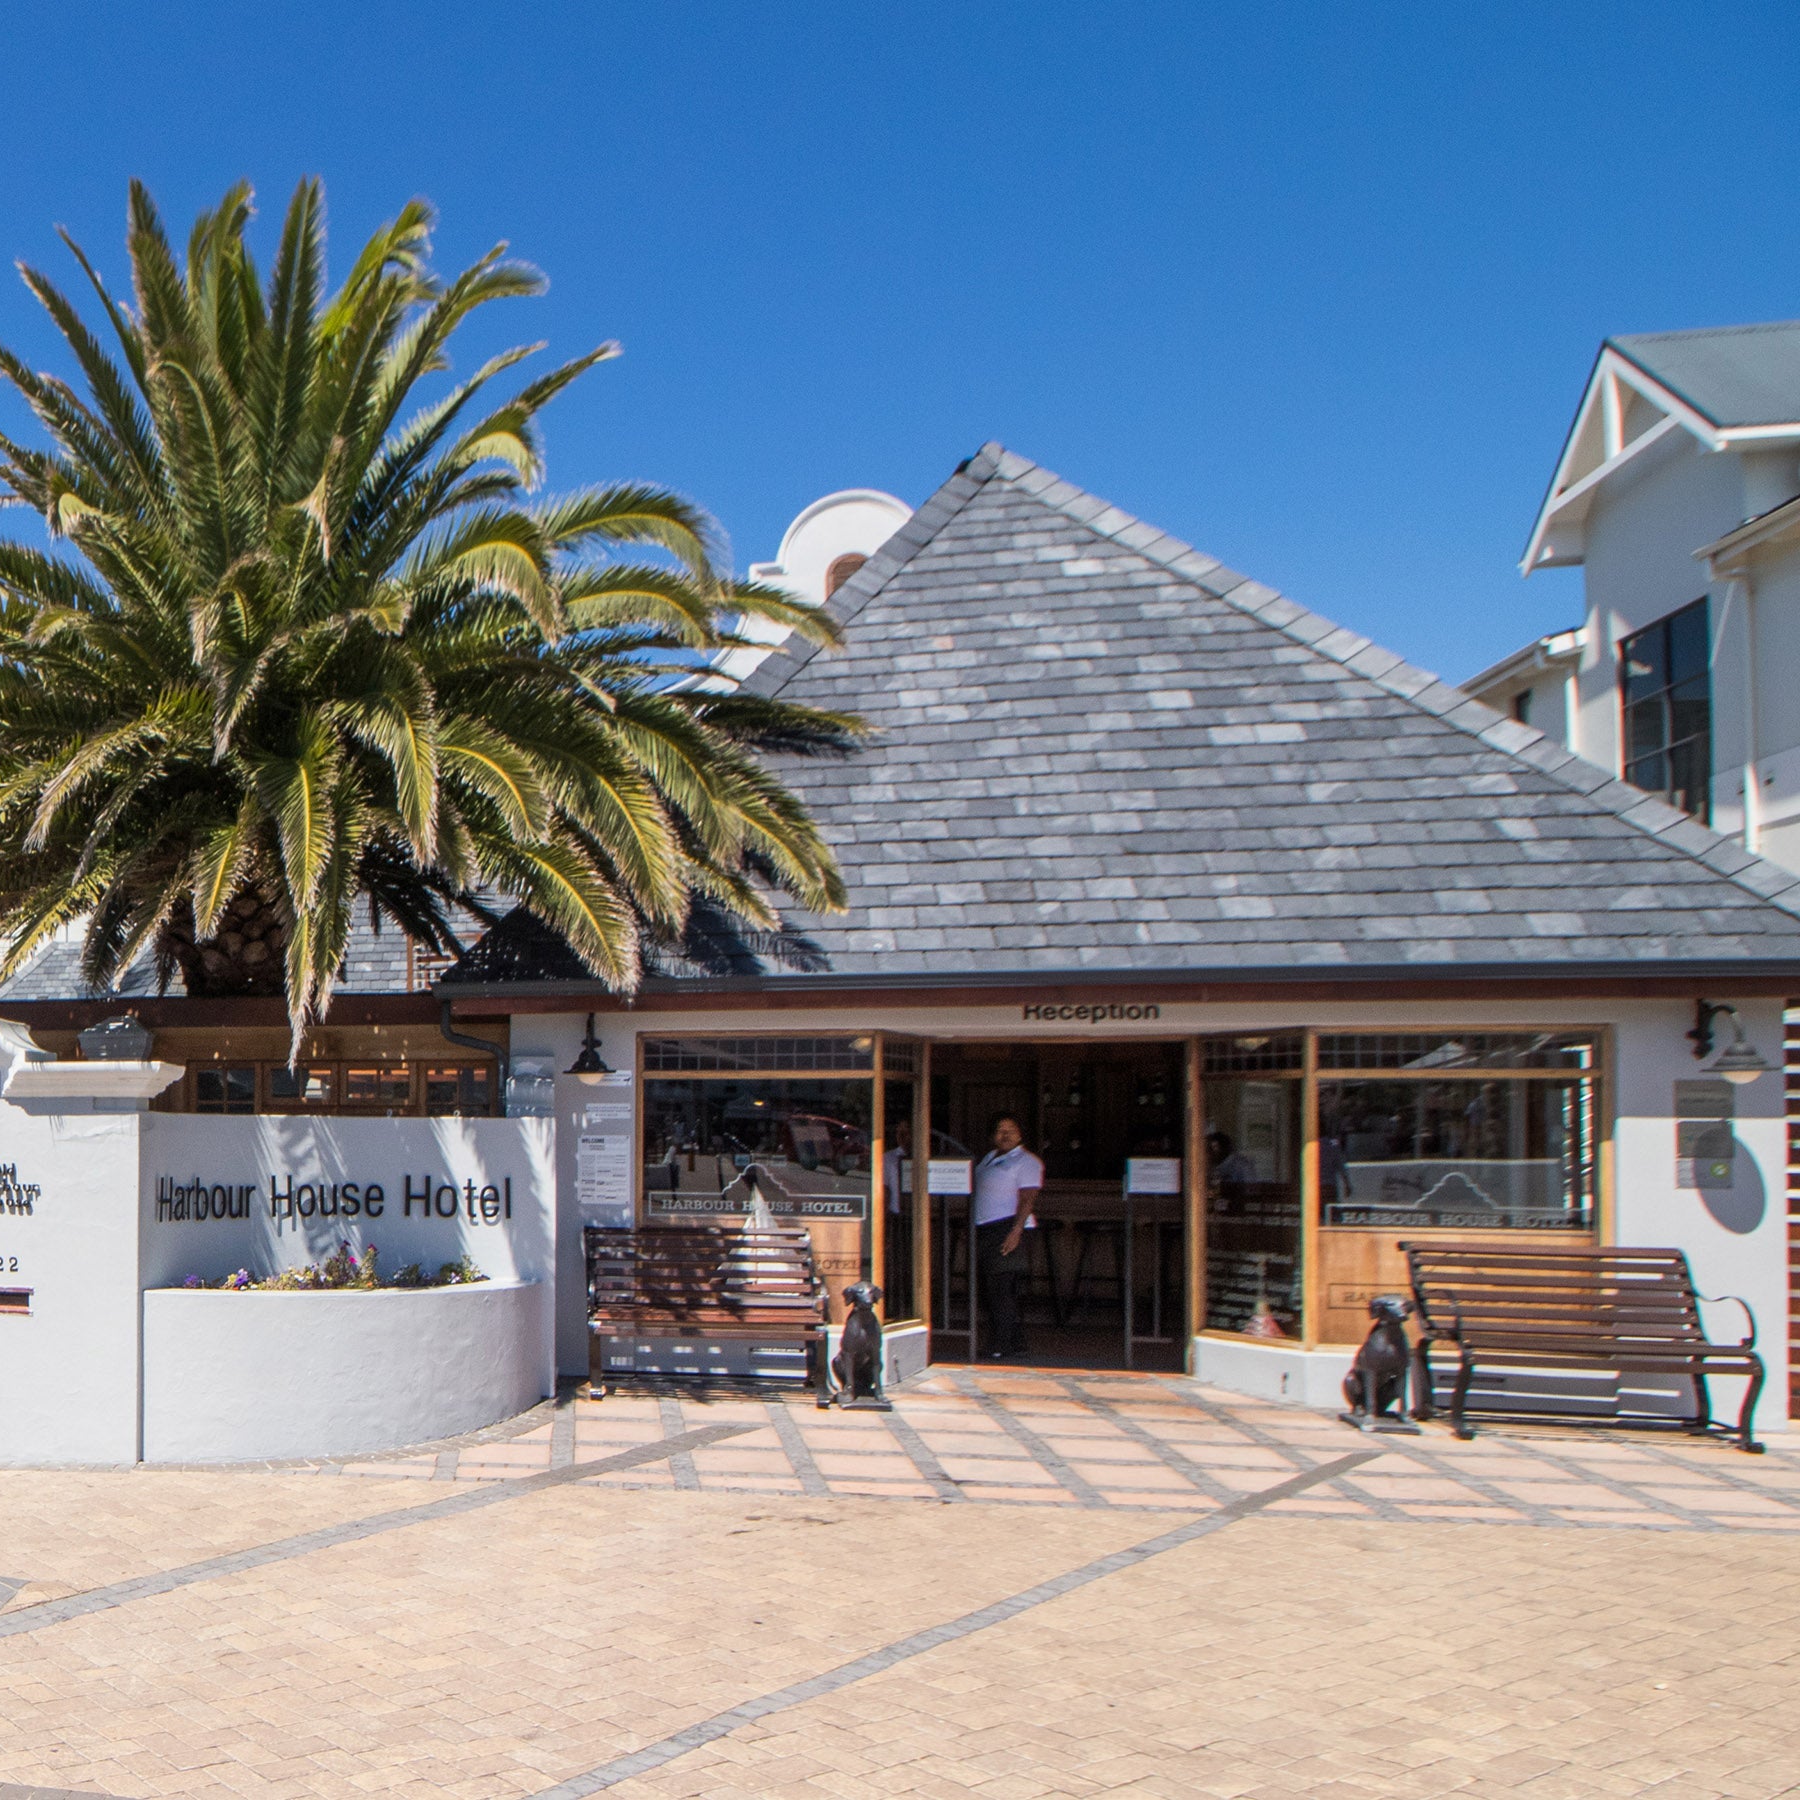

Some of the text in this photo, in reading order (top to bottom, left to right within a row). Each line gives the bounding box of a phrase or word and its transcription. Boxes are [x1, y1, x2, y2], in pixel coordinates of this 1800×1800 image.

[1023, 1003, 1160, 1024] Reception
[157, 1175, 512, 1222] Harbour House Hotel
[661, 1199, 735, 1211] HARBOUR
[801, 1202, 853, 1213] HOTEL
